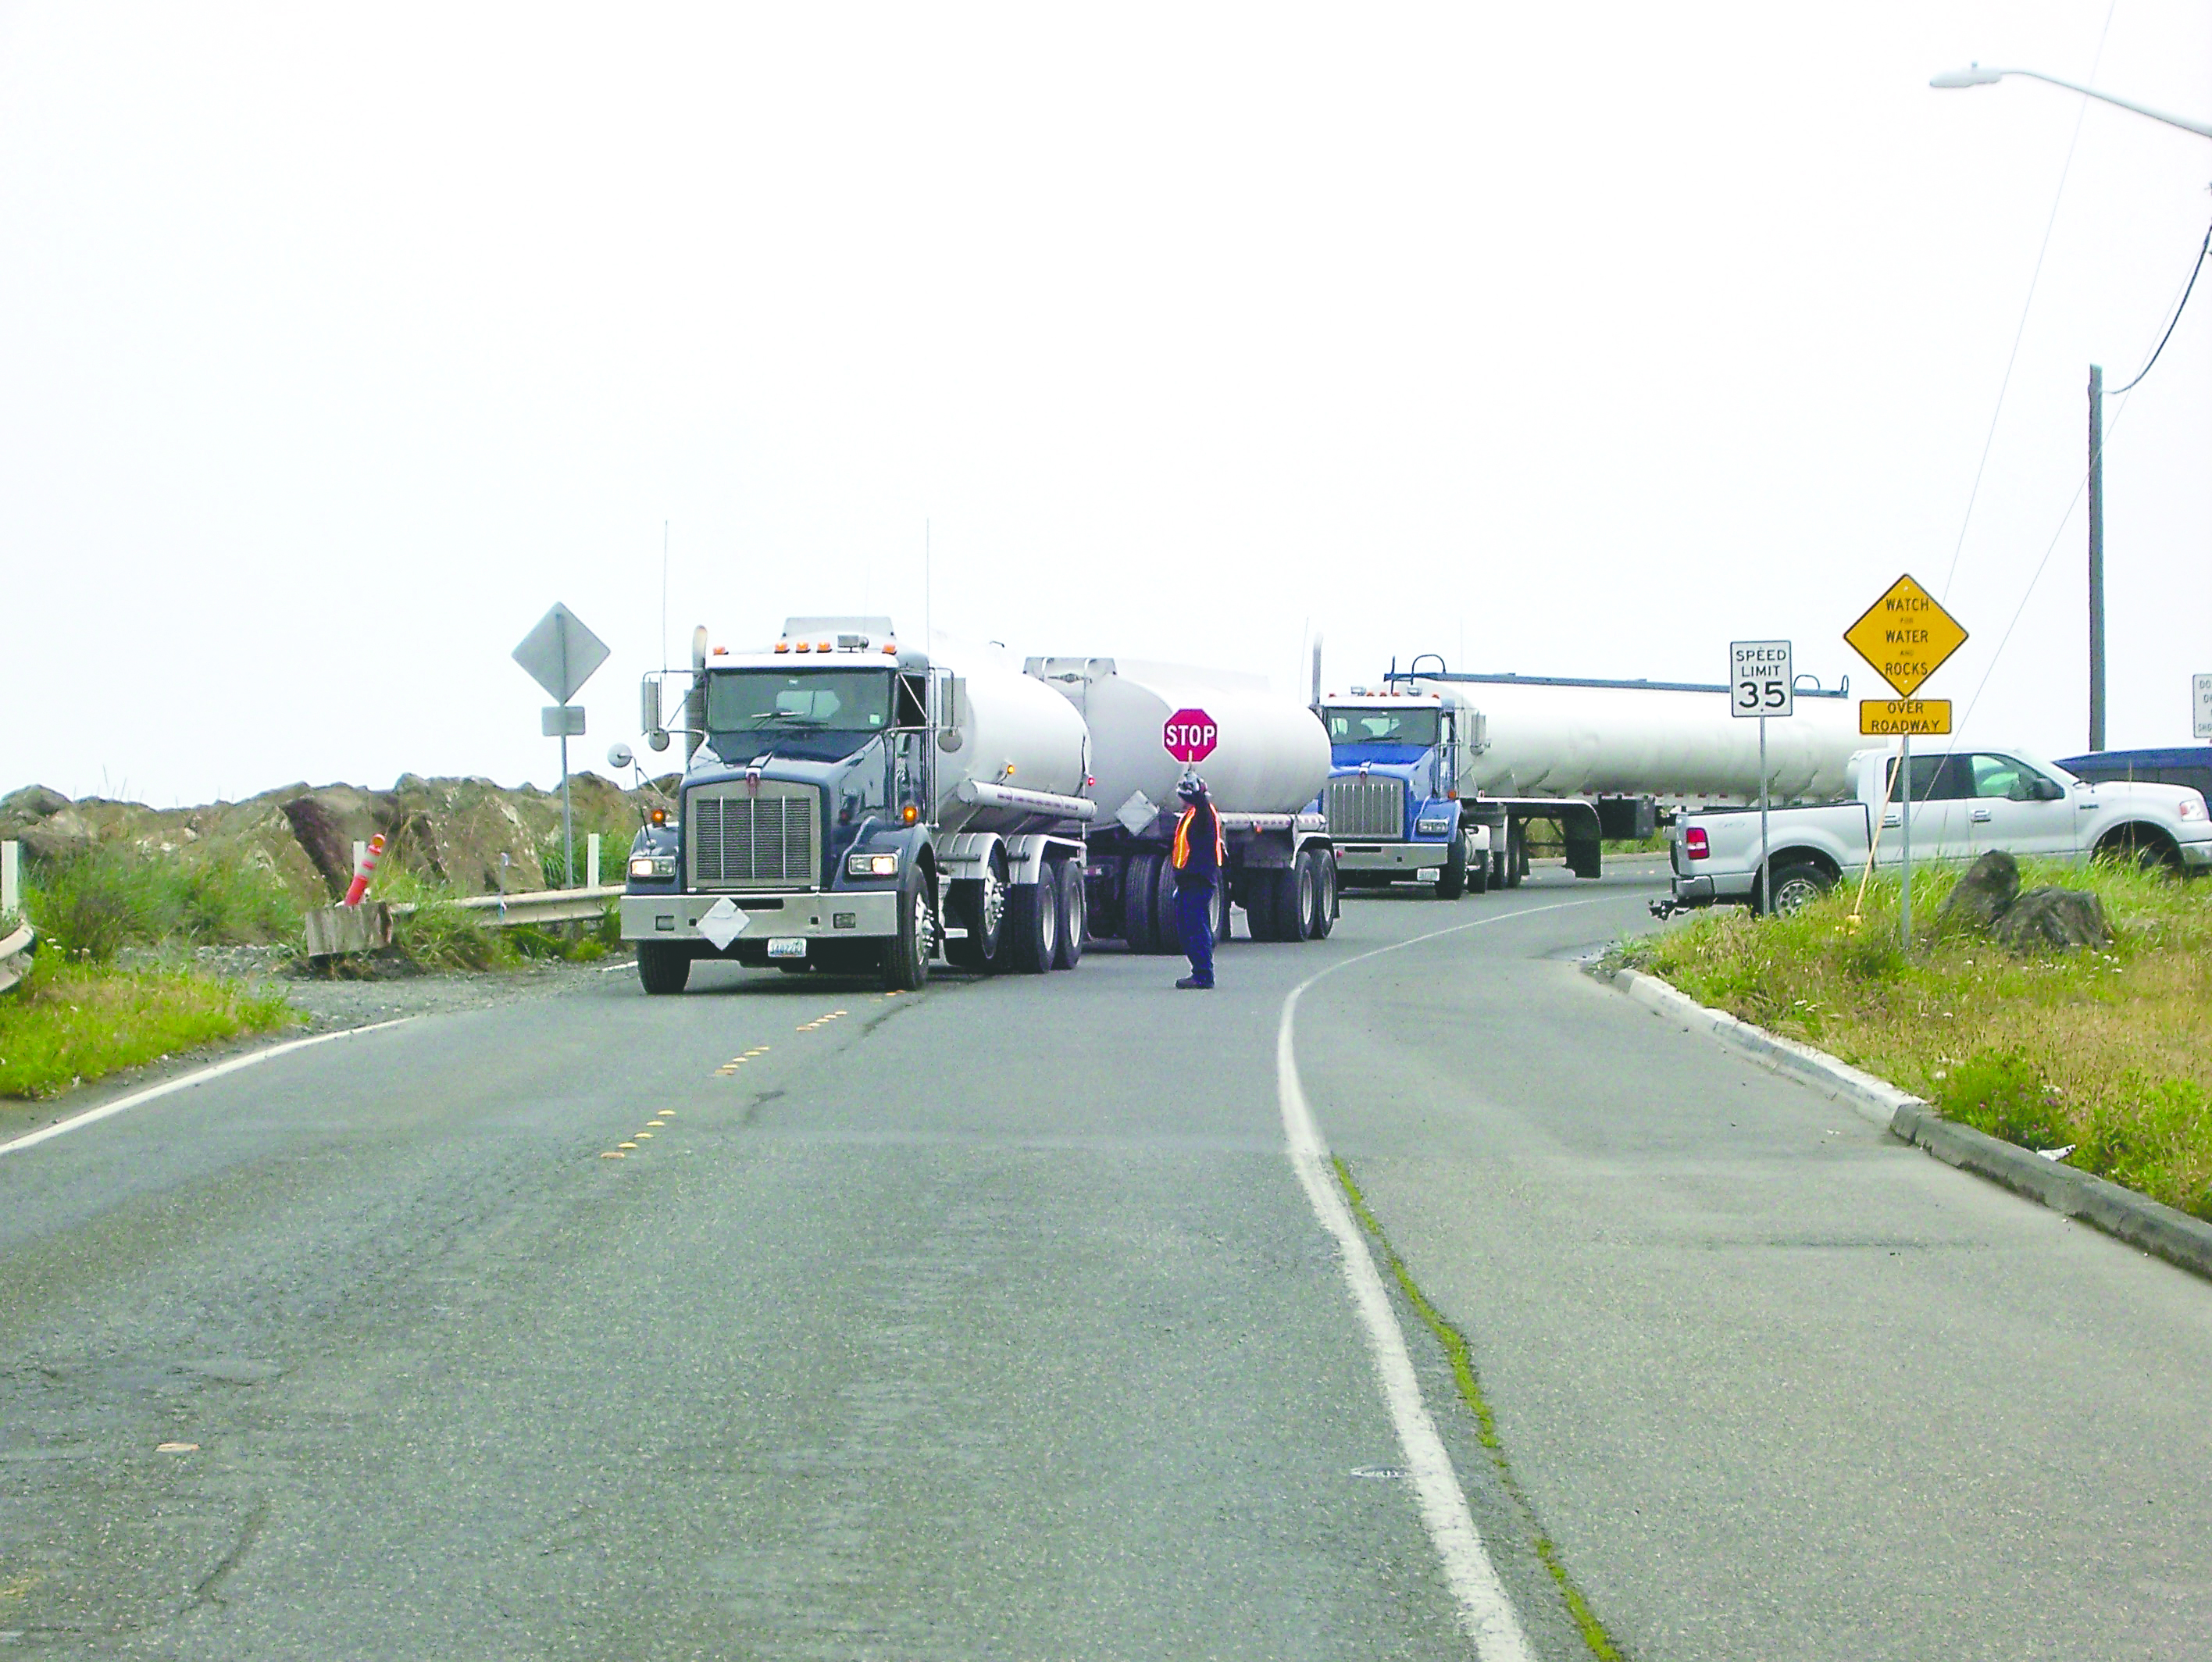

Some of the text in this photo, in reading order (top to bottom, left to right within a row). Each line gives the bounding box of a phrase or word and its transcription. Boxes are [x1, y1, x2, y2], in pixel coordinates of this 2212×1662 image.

[1886, 598, 1928, 612] WATCH
[1886, 630, 1928, 643] WATER
[1736, 649, 1786, 662] SPEED
[1741, 665, 1780, 677] LIMIT
[1886, 662, 1928, 676] ROCKS
[2200, 679, 2211, 689] DO
[1739, 681, 1786, 708] 35
[1888, 702, 1924, 714] OVER
[1871, 719, 1940, 732] ROADWAY
[1165, 724, 1215, 747] STOP
